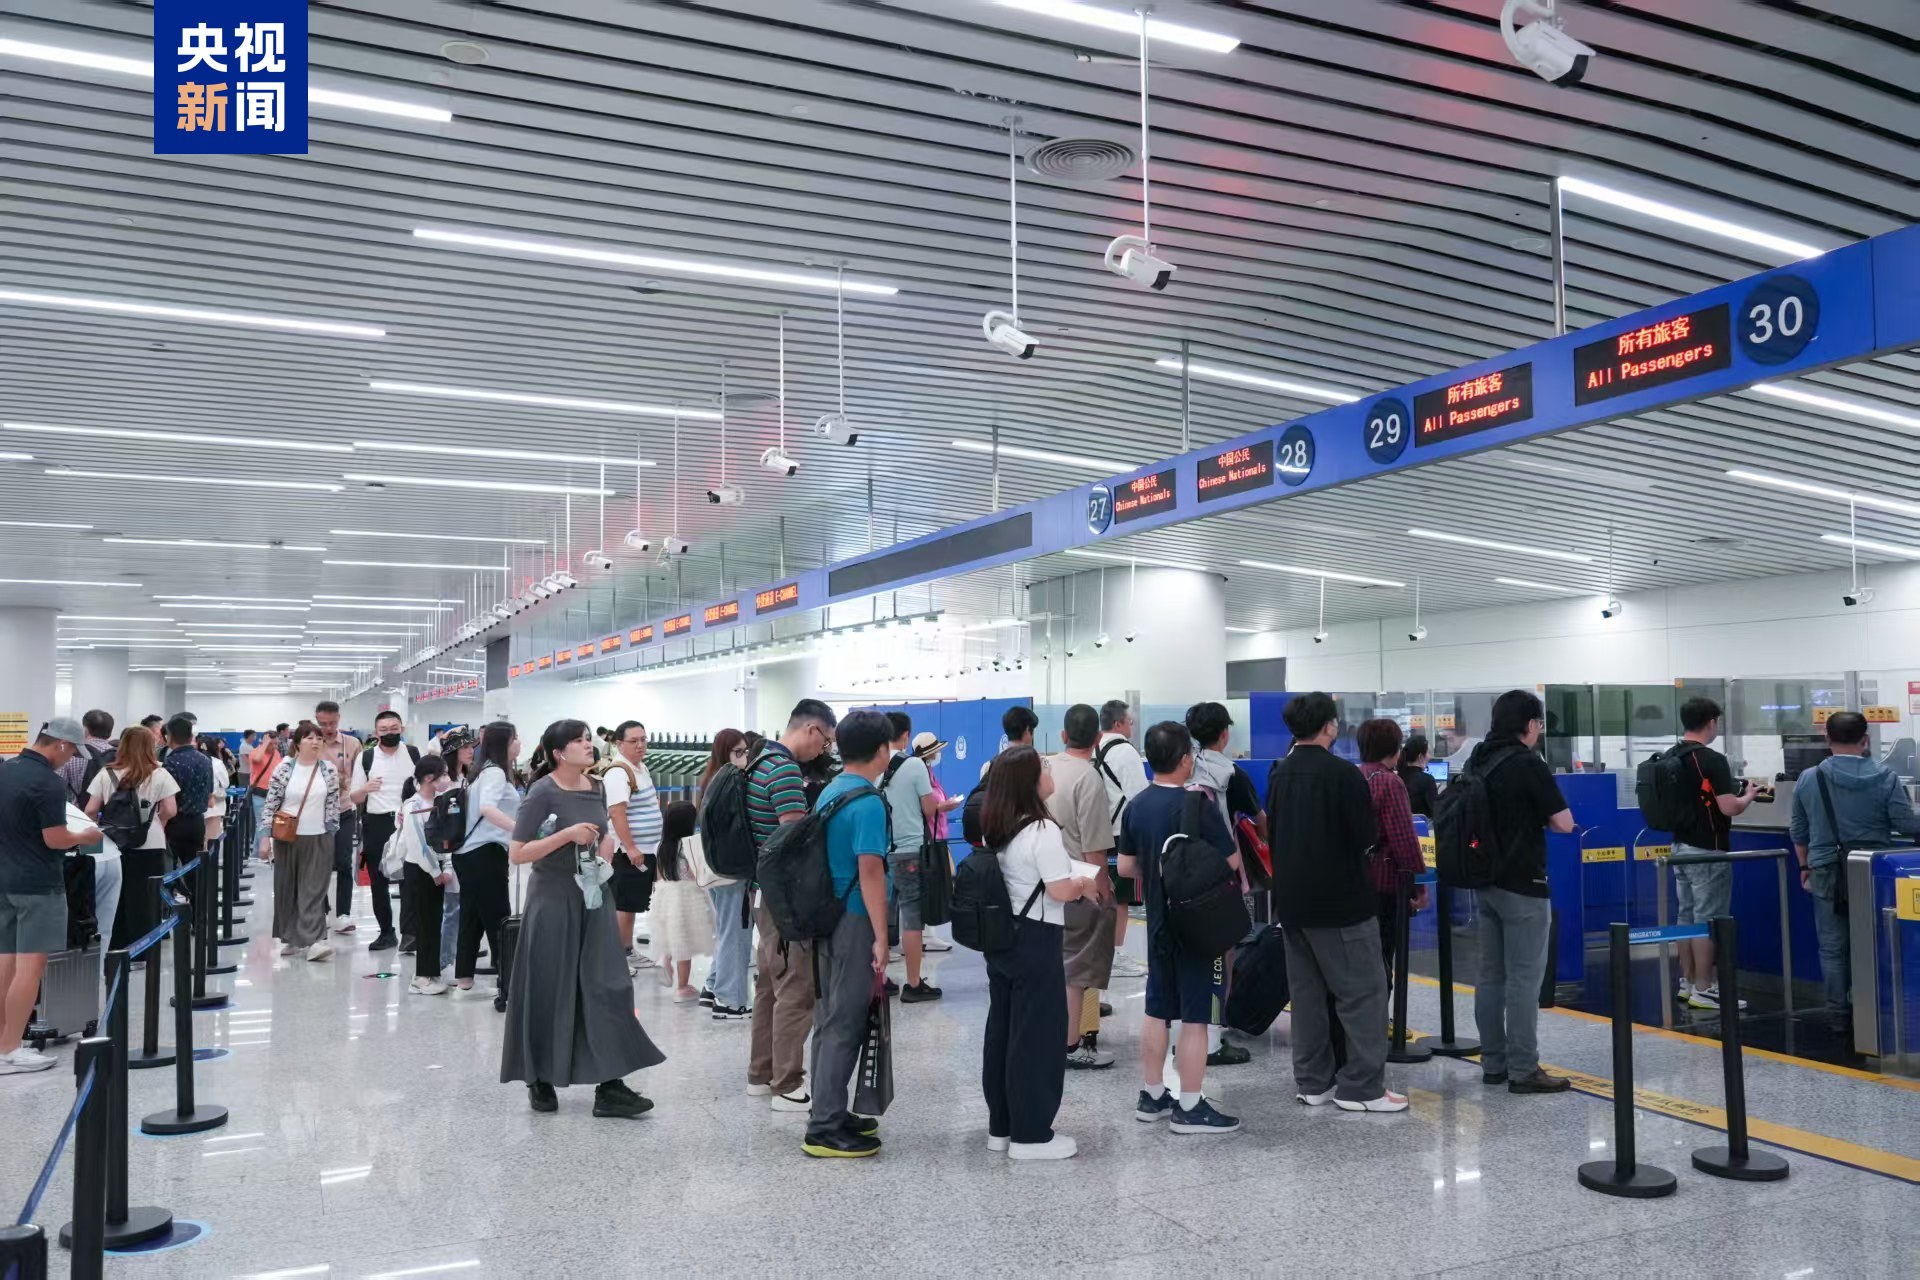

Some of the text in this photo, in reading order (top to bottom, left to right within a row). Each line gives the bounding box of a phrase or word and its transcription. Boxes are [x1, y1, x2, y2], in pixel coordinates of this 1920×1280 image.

[1749, 296, 1804, 344] 30
[1617, 316, 1691, 356] 所有旅客
[1587, 343, 1713, 389] All Passengers
[1447, 372, 1503, 405] 所有旅客
[1423, 397, 1520, 433] All Passengers
[1369, 413, 1401, 449] 29
[1218, 447, 1251, 469] 中国公民
[1280, 439, 1307, 468] 28
[1130, 474, 1159, 494] 中国公民
[1198, 462, 1267, 490] Chinese Nationals
[1088, 497, 1107, 522] 27
[1115, 488, 1171, 513] Chinese Nationals
[1213, 973, 1222, 985] LE
